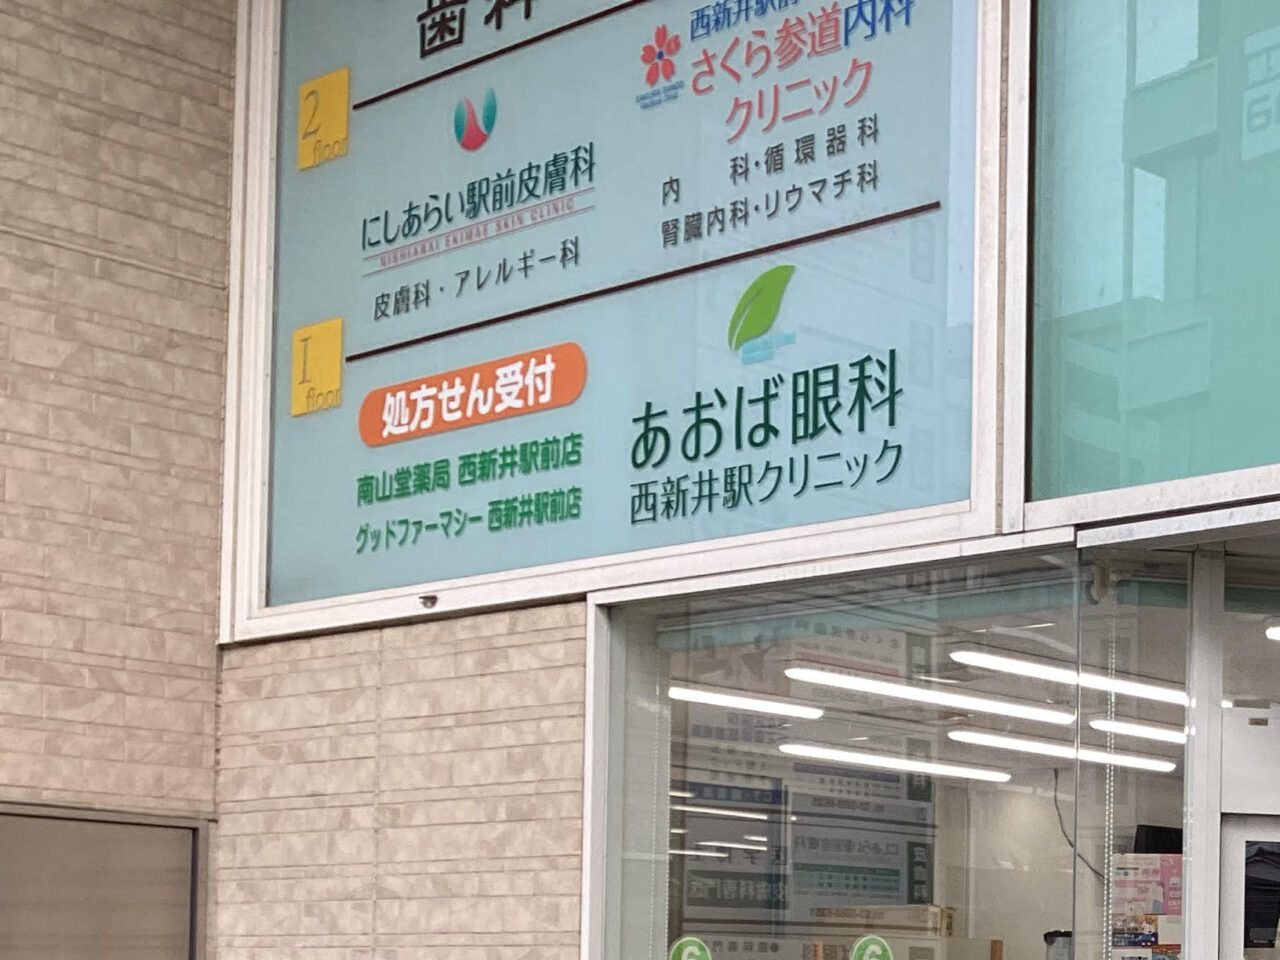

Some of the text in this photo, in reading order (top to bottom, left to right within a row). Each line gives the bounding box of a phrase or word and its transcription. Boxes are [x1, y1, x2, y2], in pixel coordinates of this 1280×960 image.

[302, 90, 320, 140] 2
[725, 57, 873, 144] クリニック
[311, 136, 349, 166] floor
[361, 141, 596, 250] にしあらい駅前皮膚科
[661, 160, 879, 248] 腎臓内科・リウマチ科
[374, 236, 580, 321] 皮膚科・アレルギー科
[382, 353, 556, 438] 処方せん受付
[631, 349, 903, 470] あおば眼科
[356, 432, 584, 506] 南山堂薬局 西新井駅前店
[630, 439, 903, 525] 西新井駅クリニック
[356, 486, 582, 554] グッドファーマシー 西新井駅前店
